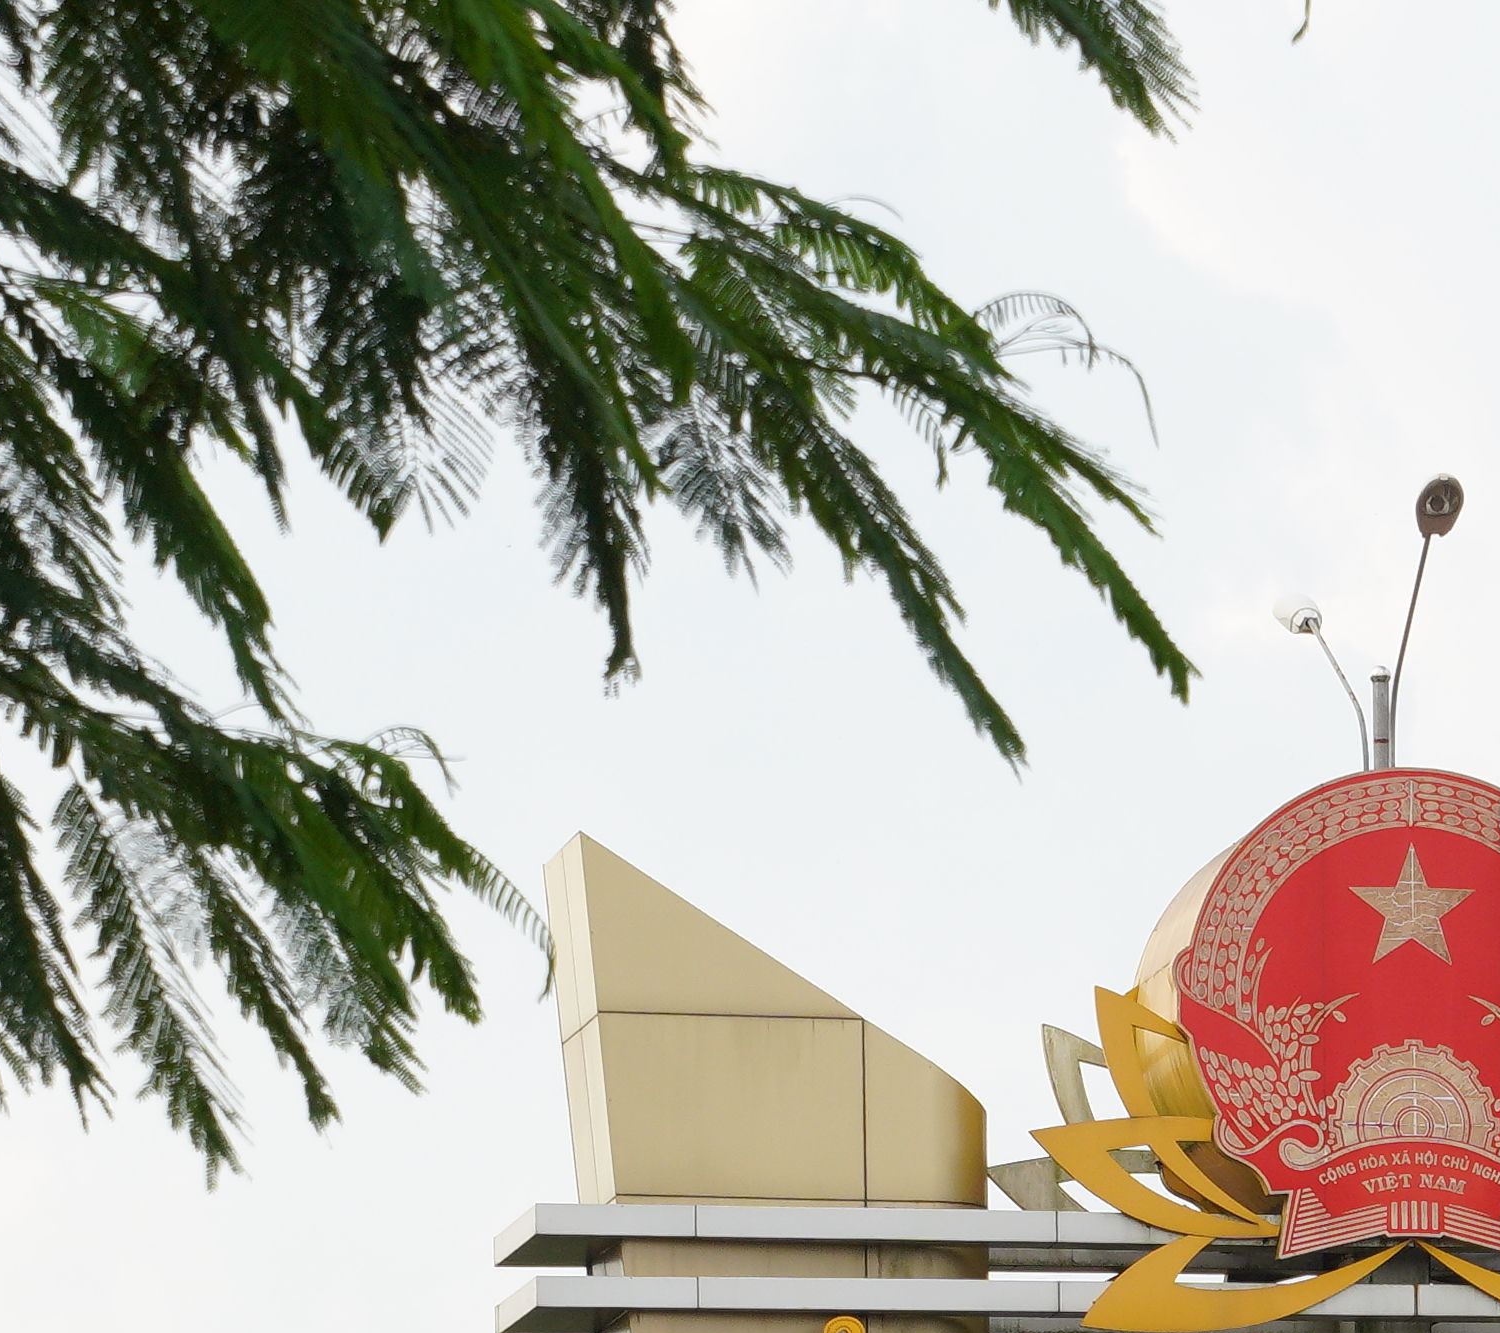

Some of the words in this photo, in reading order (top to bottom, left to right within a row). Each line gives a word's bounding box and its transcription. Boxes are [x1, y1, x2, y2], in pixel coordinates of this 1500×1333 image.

[1318, 1161, 1357, 1186] CỘNG
[1358, 1153, 1389, 1171] HÒA
[1391, 1150, 1411, 1165] XÃ
[1414, 1150, 1438, 1169] HỘI
[1441, 1155, 1470, 1172] CHỦ
[1361, 1172, 1413, 1194] VIỆT
[1419, 1173, 1468, 1195] NAM
